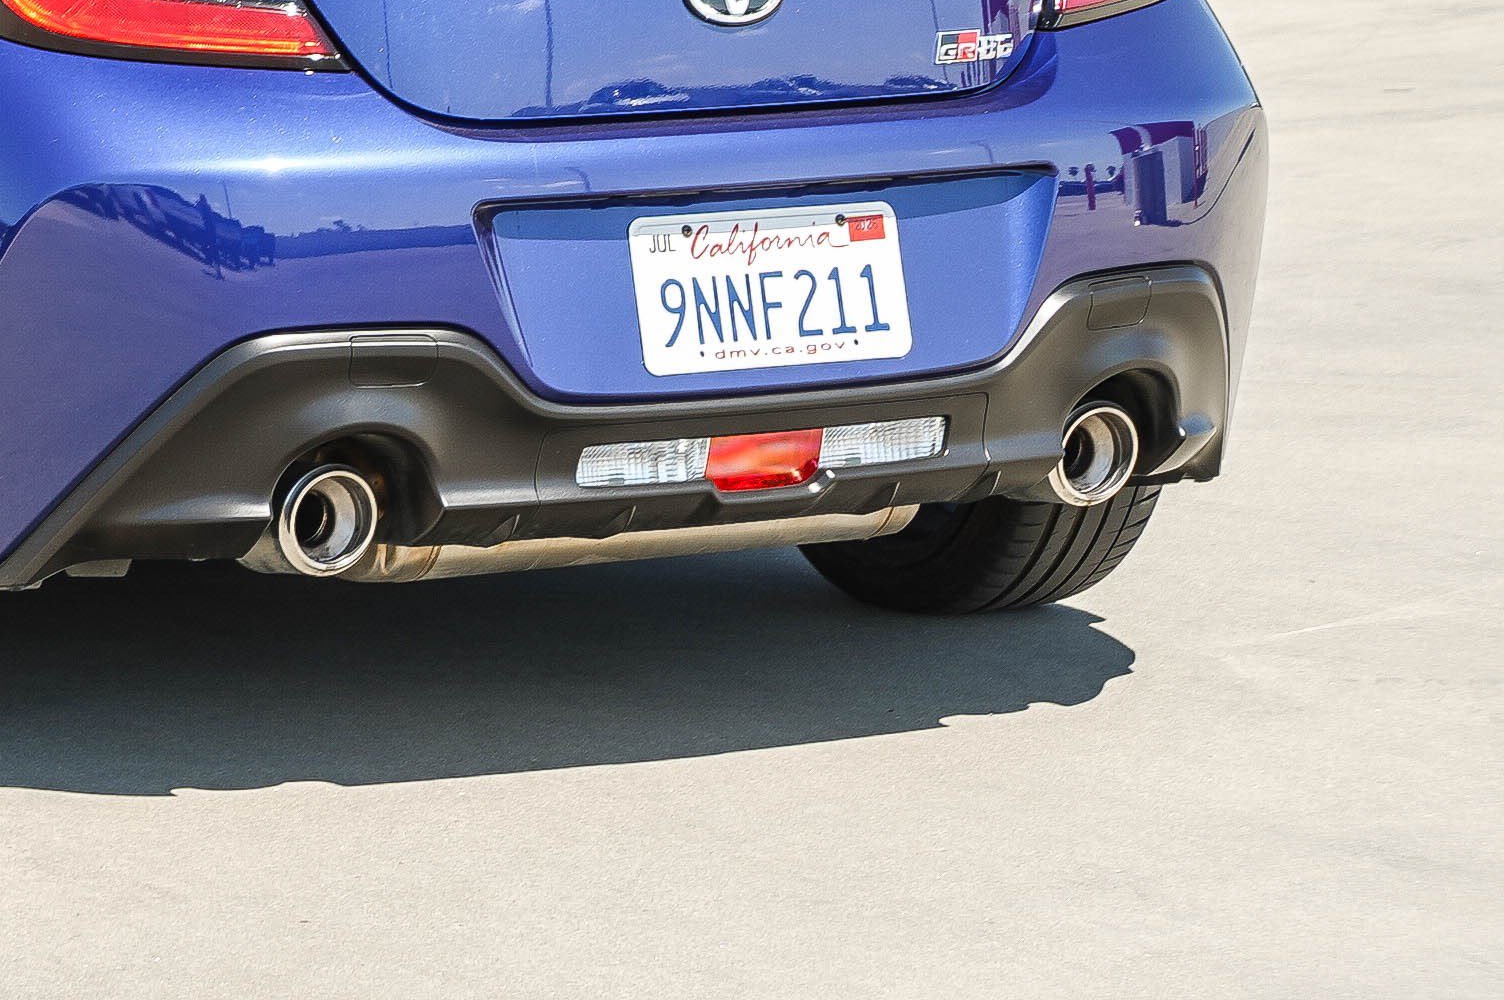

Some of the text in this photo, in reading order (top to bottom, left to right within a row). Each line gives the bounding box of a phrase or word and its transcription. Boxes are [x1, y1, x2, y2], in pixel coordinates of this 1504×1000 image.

[649, 234, 677, 253] JUL
[691, 221, 848, 265] California
[660, 264, 890, 347] 9NNF211
[715, 341, 846, 360] dmv.ca.gov
